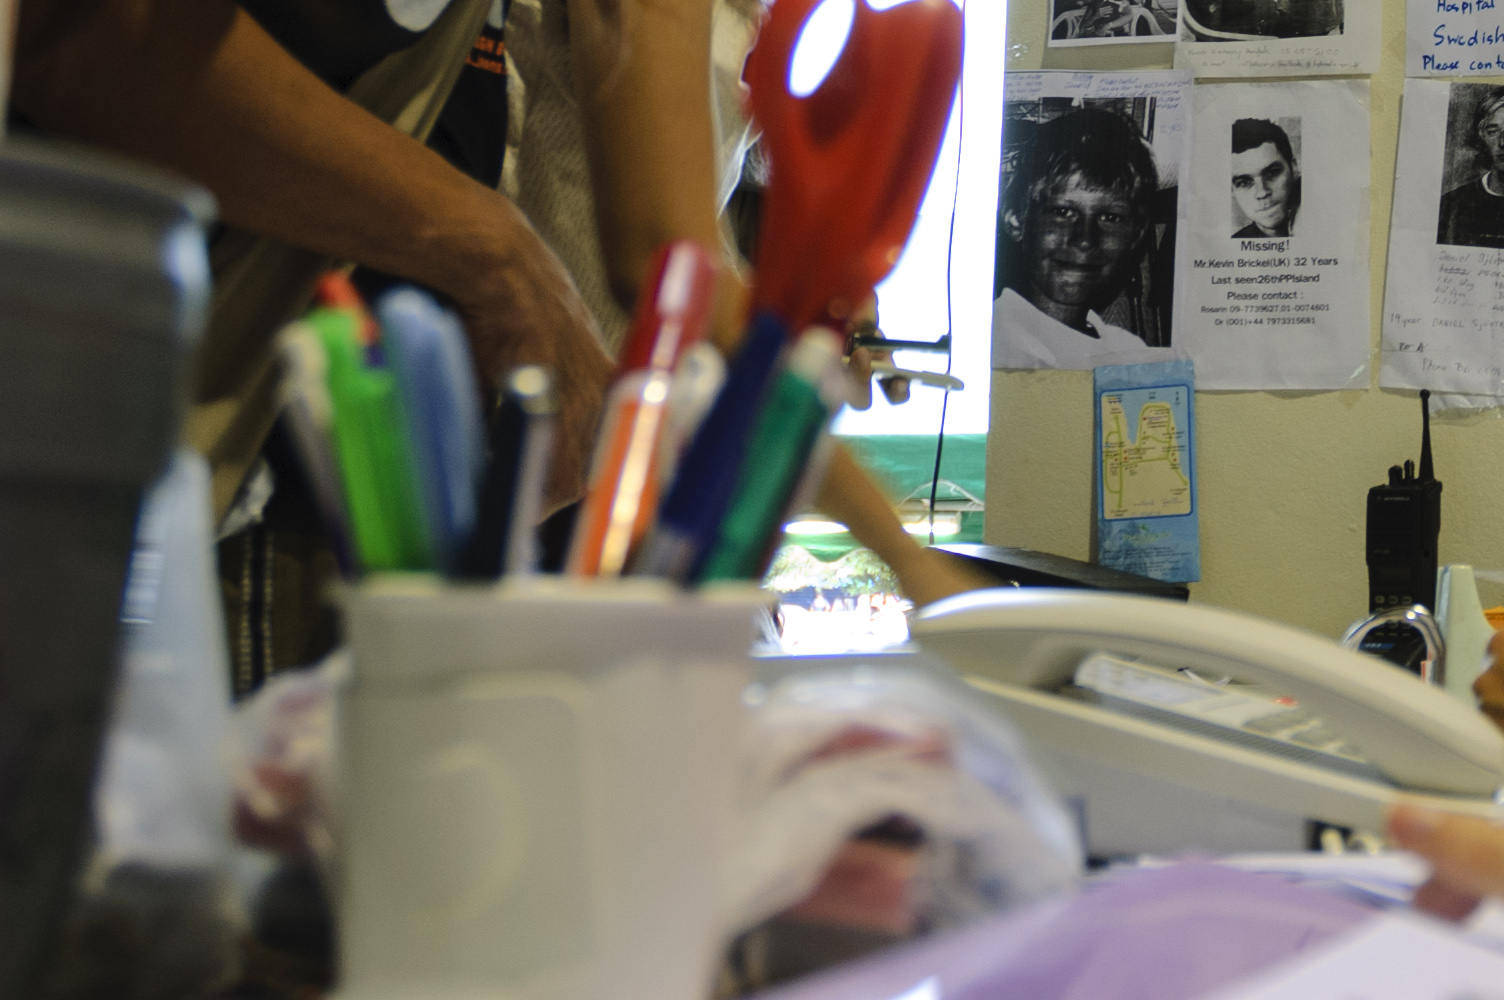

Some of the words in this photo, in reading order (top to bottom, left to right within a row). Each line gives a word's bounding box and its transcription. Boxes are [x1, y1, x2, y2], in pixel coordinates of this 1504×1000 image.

[1422, 55, 1460, 71] Please
[1241, 240, 1290, 252] Missing!
[1294, 257, 1307, 267] 32
[1310, 256, 1338, 266] Years
[1211, 275, 1231, 285] Last
[1227, 291, 1259, 301] Please
[1261, 291, 1298, 300] contact
